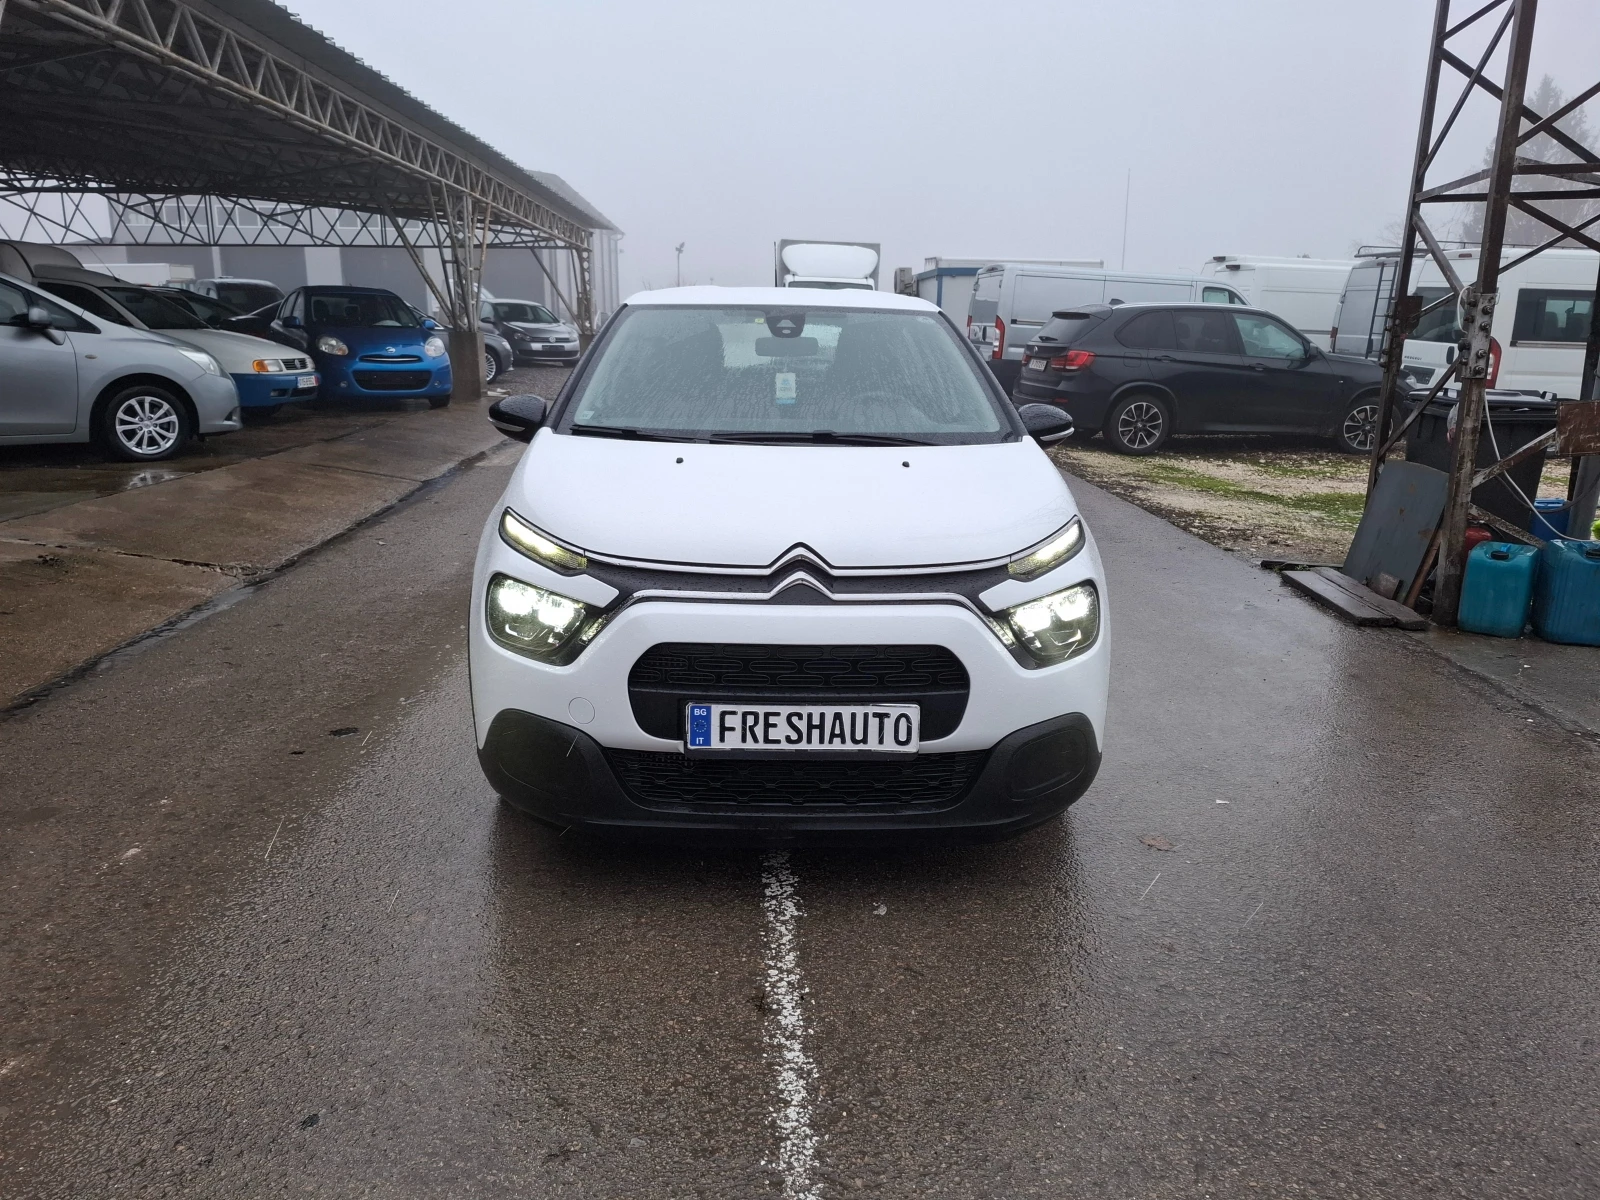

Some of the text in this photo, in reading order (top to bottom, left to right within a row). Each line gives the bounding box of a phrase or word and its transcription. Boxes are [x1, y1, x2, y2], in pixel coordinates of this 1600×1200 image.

[694, 708, 707, 716] BG
[719, 710, 912, 746] FRESHAUTO
[696, 737, 704, 745] IT
